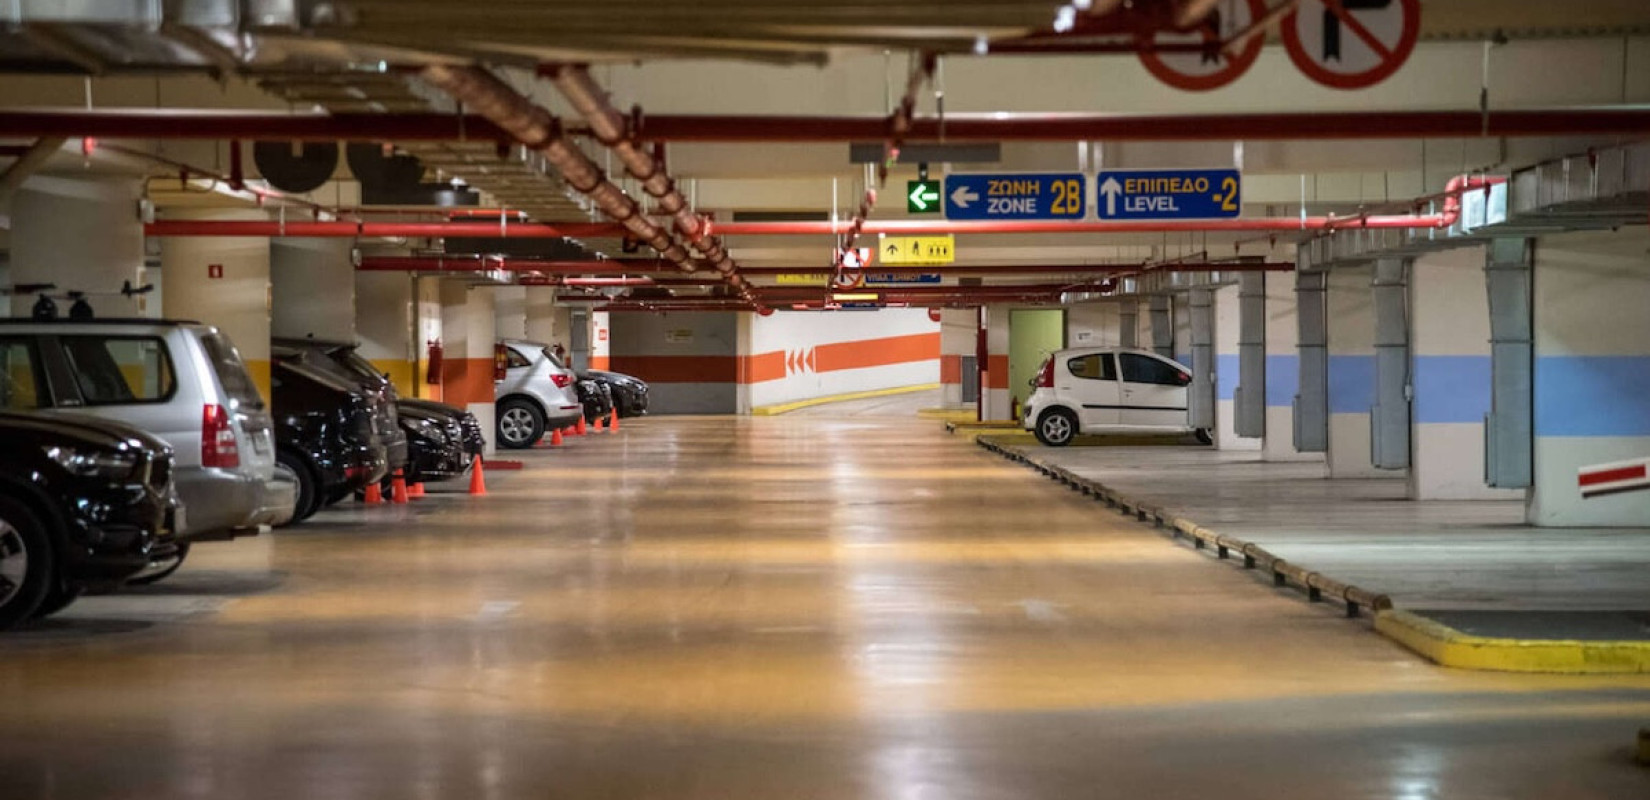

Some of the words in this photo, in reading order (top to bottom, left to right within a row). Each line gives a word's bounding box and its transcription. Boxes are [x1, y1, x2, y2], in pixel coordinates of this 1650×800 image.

[987, 180, 1040, 195] ΖΩΝΗ
[1124, 177, 1209, 194] ΕΠΙΠΕΔΟ
[1050, 180, 1080, 214] 2B
[1212, 177, 1237, 211] -2
[987, 197, 1037, 213] ZONE
[1125, 196, 1180, 212] LEVEL
